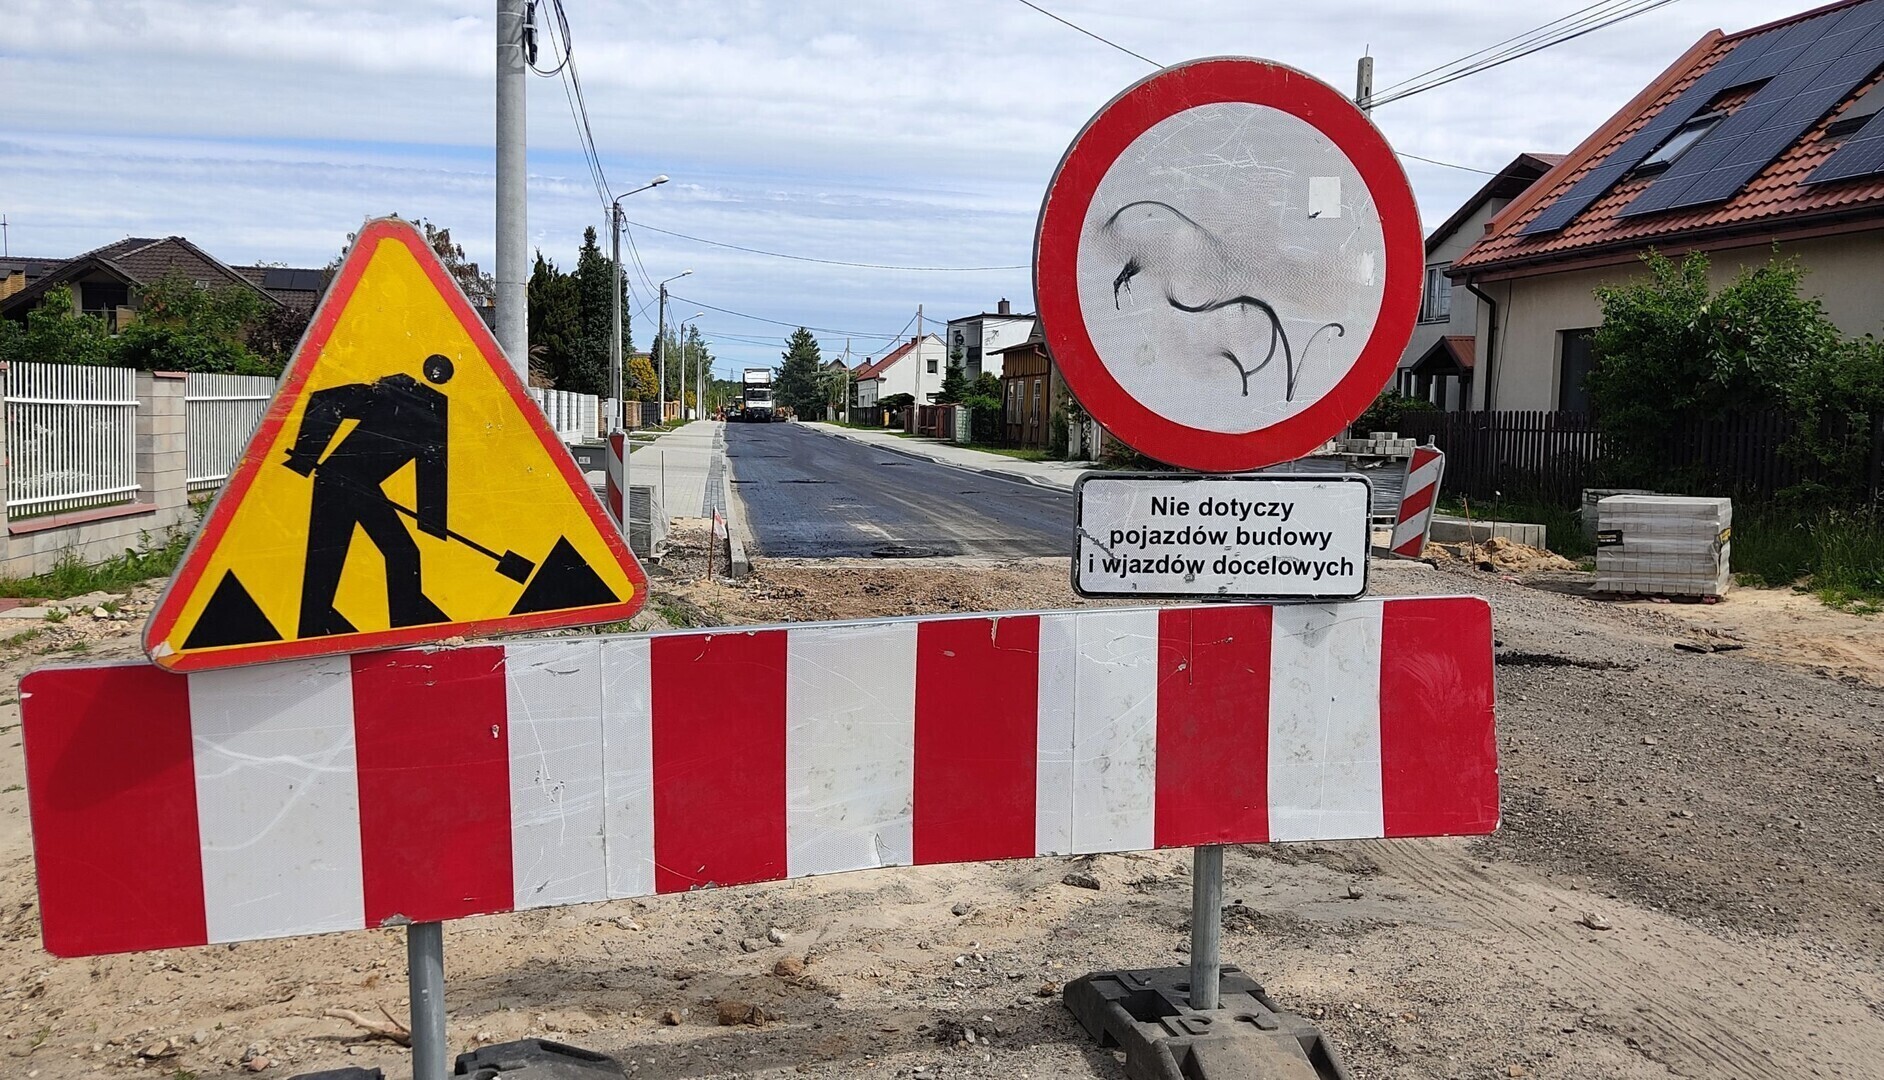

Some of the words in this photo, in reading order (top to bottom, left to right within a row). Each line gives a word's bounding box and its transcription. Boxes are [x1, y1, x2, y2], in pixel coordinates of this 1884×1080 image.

[1151, 496, 1190, 517] Nie
[1198, 496, 1295, 522] dotyczy
[1109, 525, 1229, 550] pojazdów
[1236, 525, 1333, 551] budowy
[1088, 553, 1094, 573] i
[1102, 554, 1205, 579] wjazdów
[1212, 554, 1354, 581] docelowych
